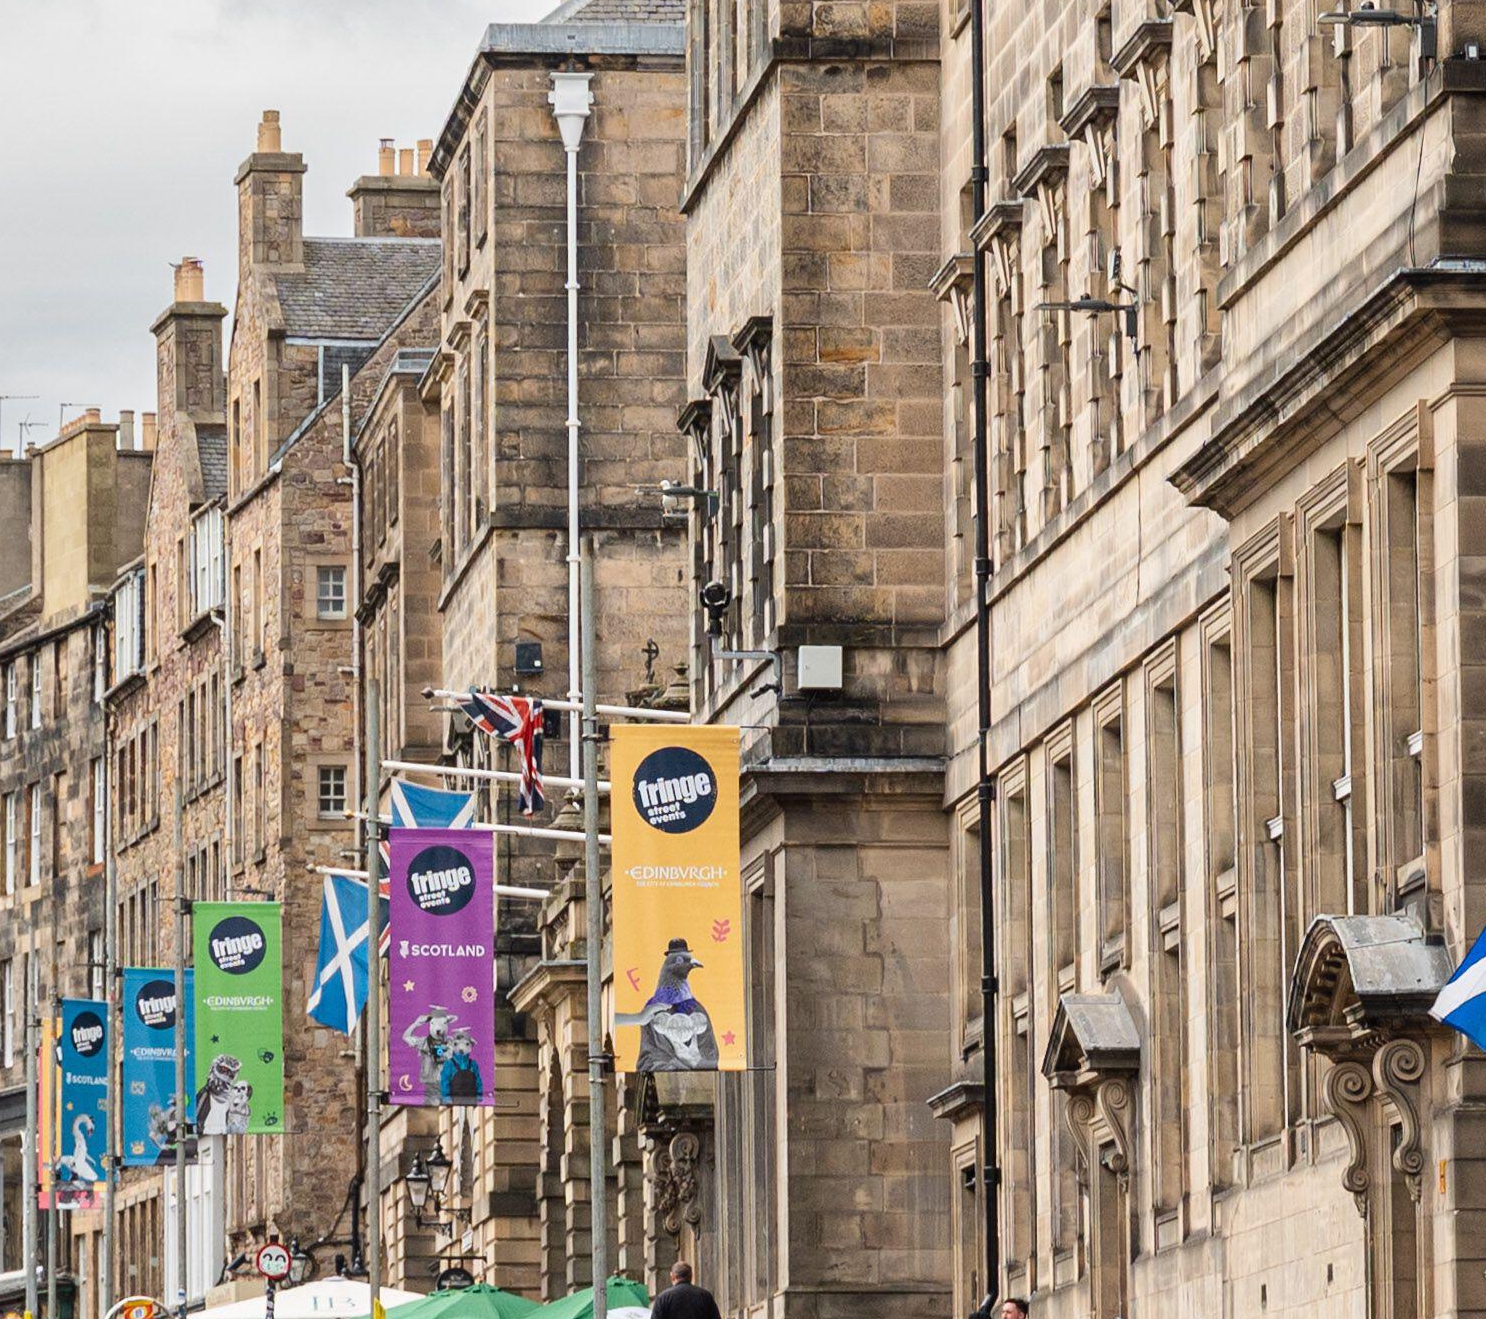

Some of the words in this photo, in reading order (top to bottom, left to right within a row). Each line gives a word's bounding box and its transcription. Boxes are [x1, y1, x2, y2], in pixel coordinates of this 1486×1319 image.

[638, 772, 711, 808] fringe
[647, 802, 680, 817] street
[649, 811, 686, 825] events
[411, 866, 471, 895] fringe
[212, 933, 262, 958] fringe
[411, 945, 485, 957] SCOTLAND
